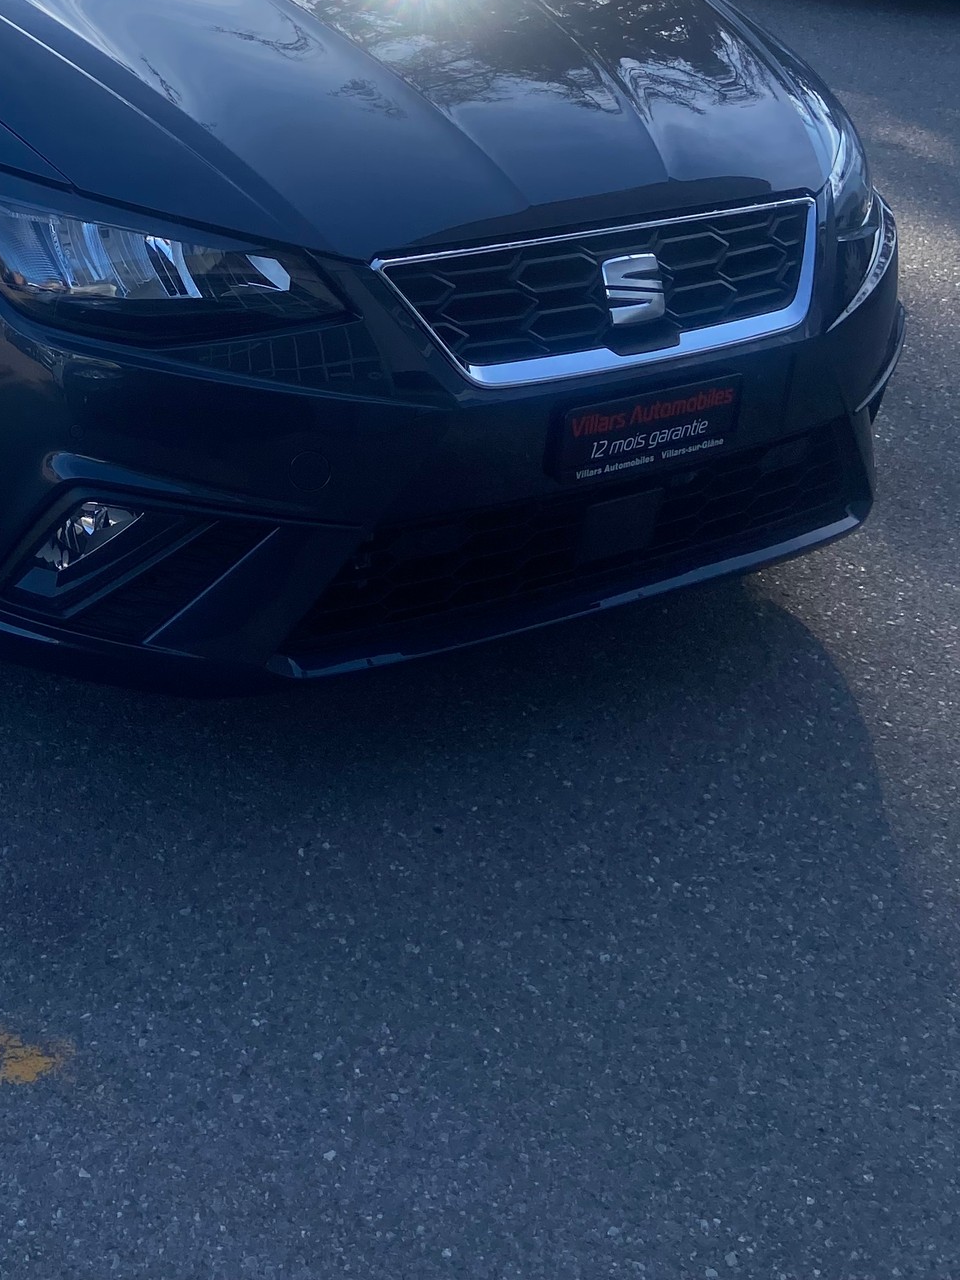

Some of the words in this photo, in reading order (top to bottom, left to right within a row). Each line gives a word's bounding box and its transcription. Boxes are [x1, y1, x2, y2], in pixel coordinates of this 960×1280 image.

[571, 412, 627, 438] Villars
[629, 387, 734, 426] Automobiles
[590, 440, 608, 459] 12
[609, 434, 646, 455] mois
[648, 418, 709, 449] garantie
[575, 467, 602, 480] Villars
[604, 454, 655, 473] Automobiles
